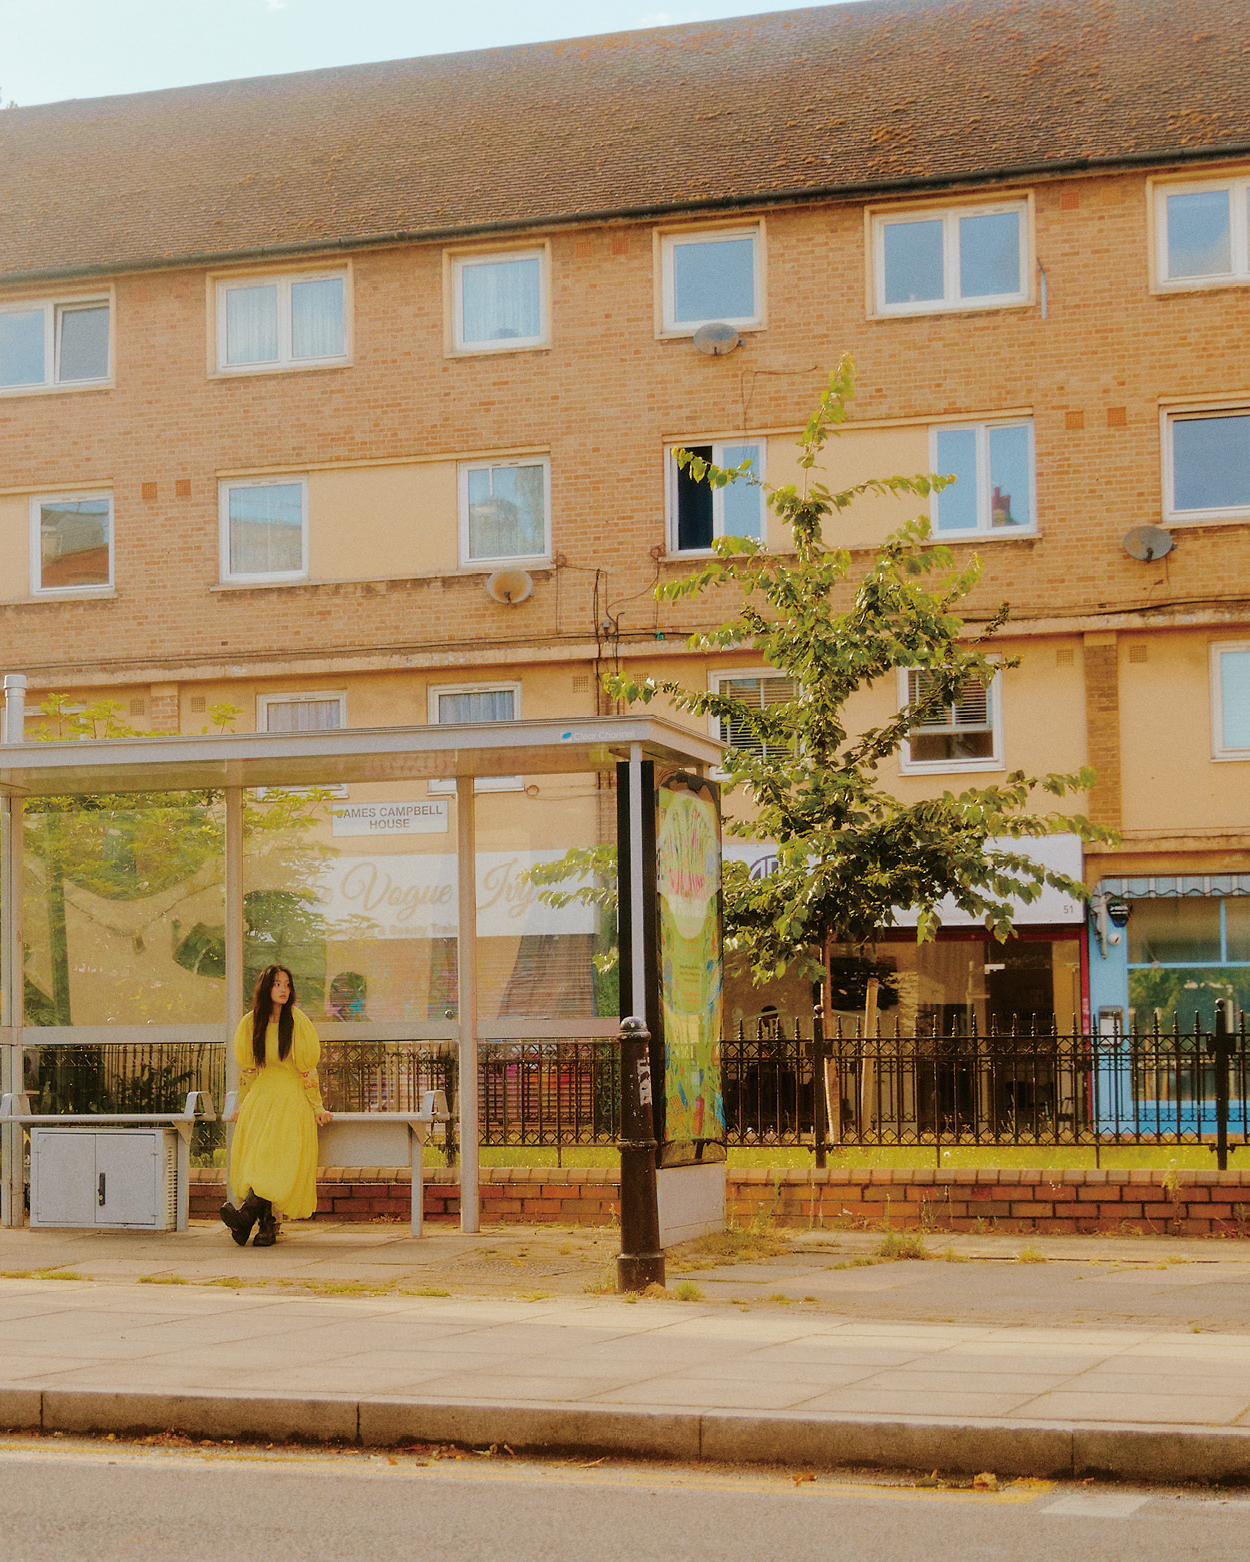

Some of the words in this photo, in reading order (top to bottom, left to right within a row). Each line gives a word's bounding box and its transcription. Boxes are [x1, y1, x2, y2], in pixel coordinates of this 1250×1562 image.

[573, 731, 597, 741] Clear
[598, 730, 635, 740] Channel
[379, 805, 443, 817] CAMPBELL
[369, 819, 410, 830] HOUSE
[341, 862, 452, 921] Vogue
[1063, 904, 1073, 914] 51
